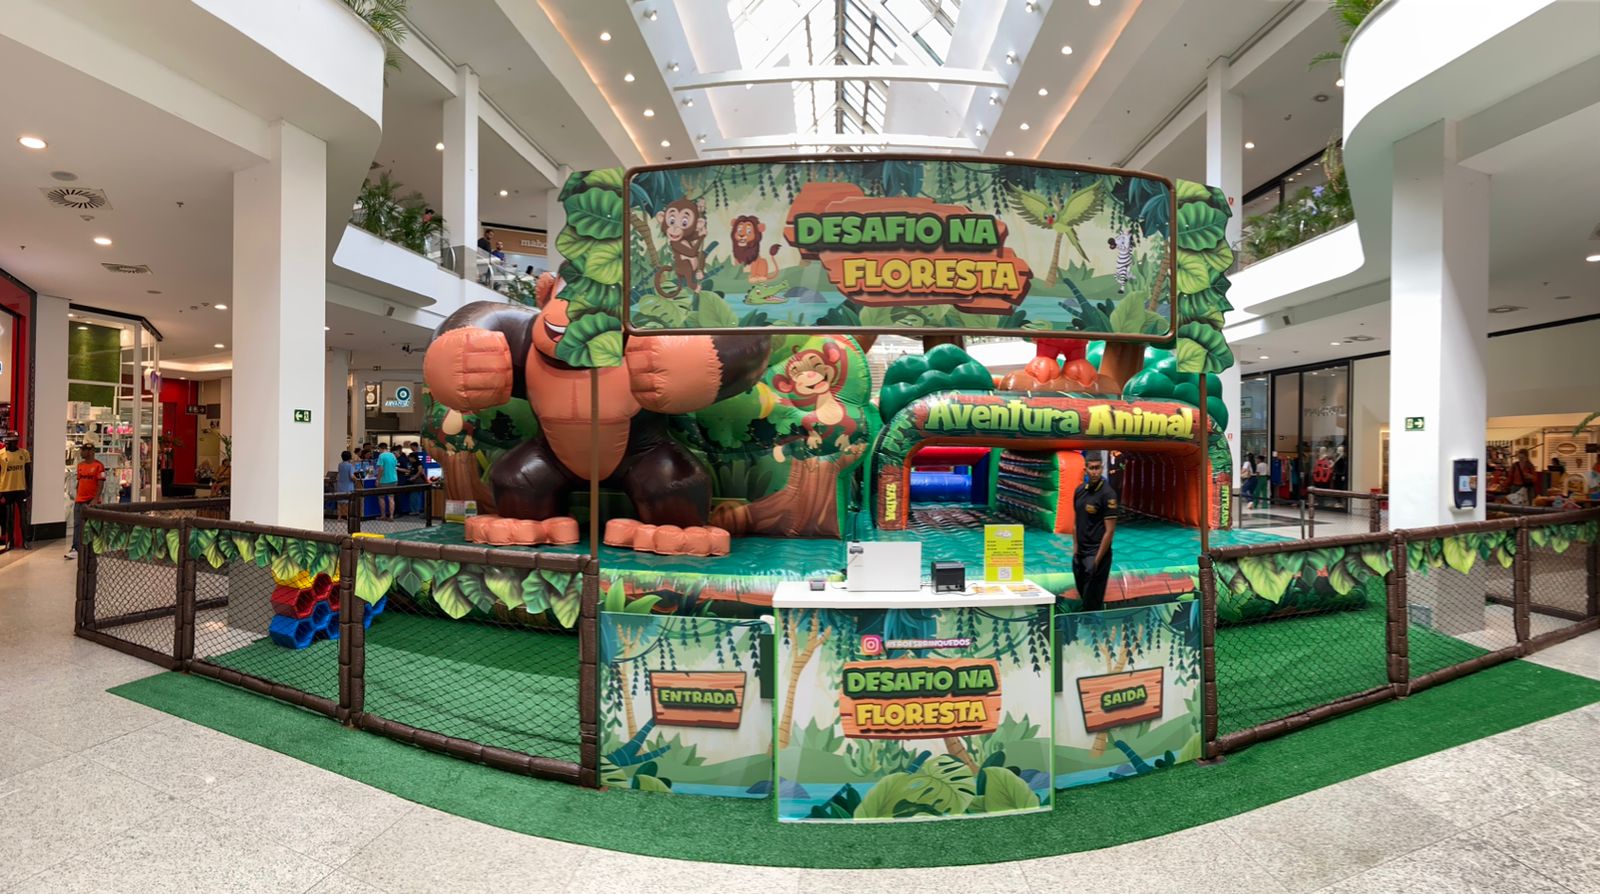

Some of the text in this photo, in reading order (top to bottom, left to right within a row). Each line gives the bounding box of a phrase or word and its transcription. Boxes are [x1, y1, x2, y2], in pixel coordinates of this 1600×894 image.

[797, 215, 998, 245] DESAFIO NA
[843, 258, 1019, 290] FLORESTA
[924, 399, 1194, 439] Aventura Animal
[846, 669, 995, 693] DESAFIO NA
[660, 689, 737, 705] ENTRADA
[855, 700, 988, 726] FLORESTA
